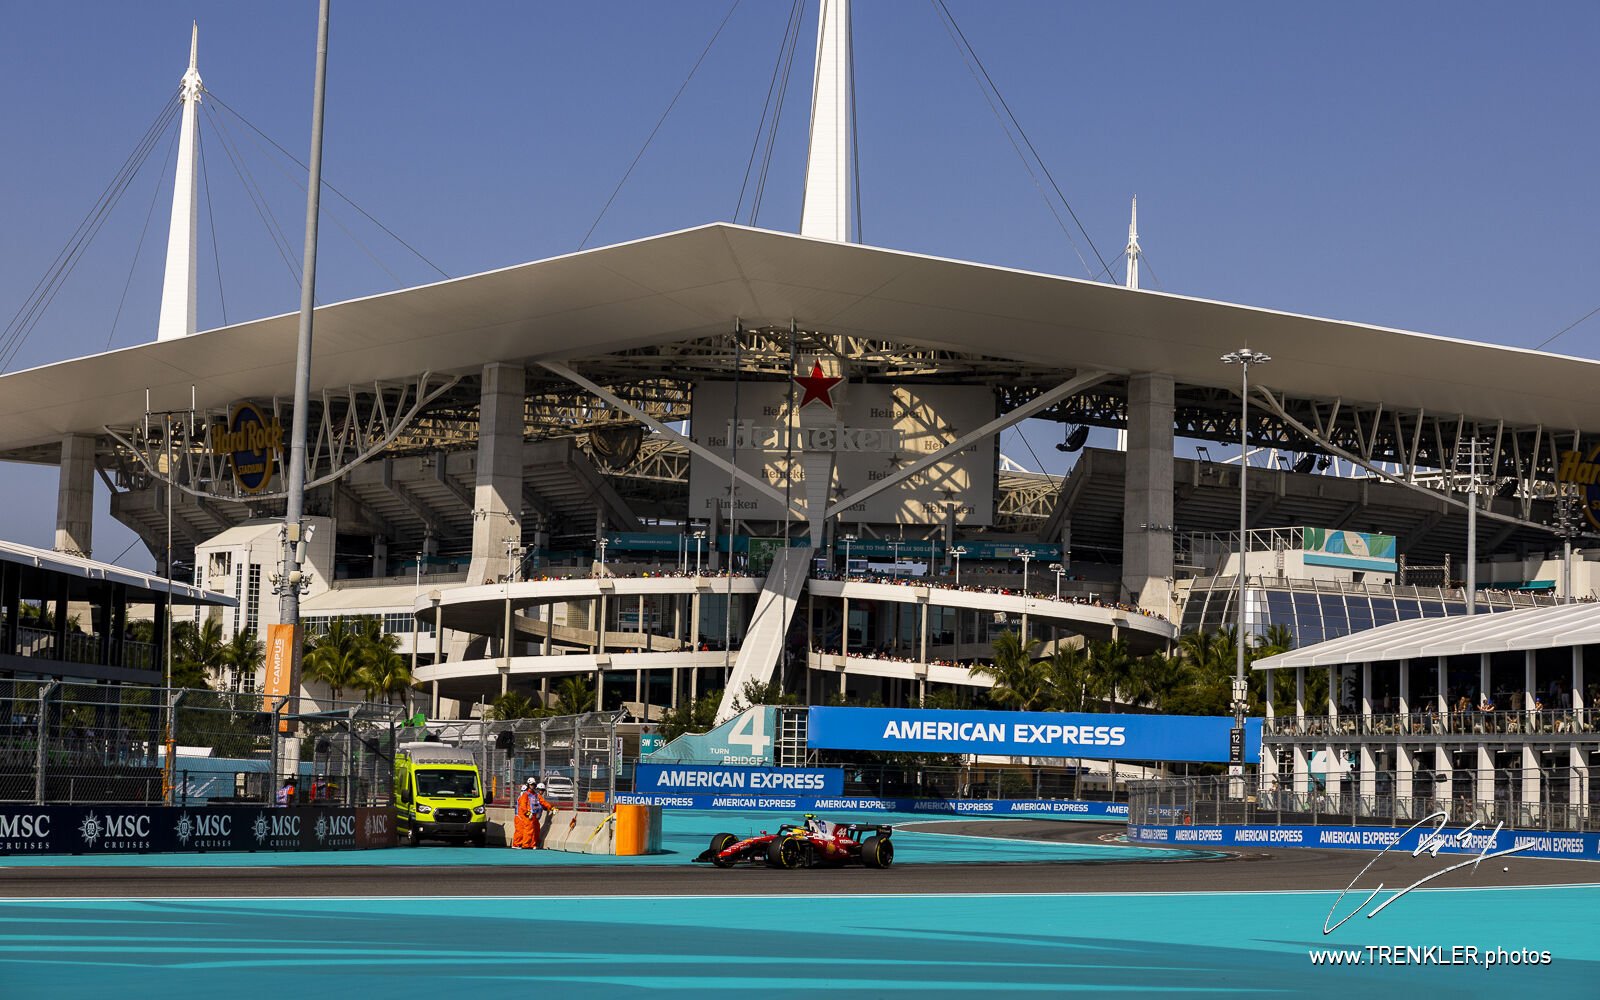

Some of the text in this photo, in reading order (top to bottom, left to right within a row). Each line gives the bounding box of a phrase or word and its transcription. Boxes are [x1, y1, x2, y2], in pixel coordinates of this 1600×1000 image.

[212, 416, 285, 457] Hard Rock
[727, 419, 903, 452] Heineken
[1558, 450, 1600, 486] Har
[705, 499, 758, 510] Hineken
[273, 638, 282, 685] CAMPUS
[728, 706, 770, 756] 4
[883, 720, 1126, 746] AMERICAN EXPRESS
[1232, 734, 1240, 743] 12
[657, 770, 825, 790] AMERICAN EXPRESS
[654, 797, 693, 806] EXPRESS
[712, 798, 796, 808] AMERICAN EXPRESS
[814, 799, 896, 810] AMERICAN EXPRESS
[914, 801, 993, 811] AMERICAN EXPRESS
[1010, 802, 1089, 812] AMERICAN EXPRESS
[0, 814, 50, 838] MSC
[105, 815, 151, 838] MSC
[195, 815, 232, 836] MSC
[271, 815, 301, 836] MSC
[329, 815, 355, 835] MSC
[372, 815, 387, 834] MSC
[194, 840, 231, 848] CRUISES
[1174, 829, 1222, 841] AMERICAN EXPRESS
[1234, 829, 1303, 842] AMERICAN EXPRESS
[1319, 830, 1400, 845] AMERICAN EXPRESS
[104, 841, 150, 849] CRUISES
[1514, 836, 1552, 852] AMERICAN
[1553, 838, 1584, 853] EXPRESS
